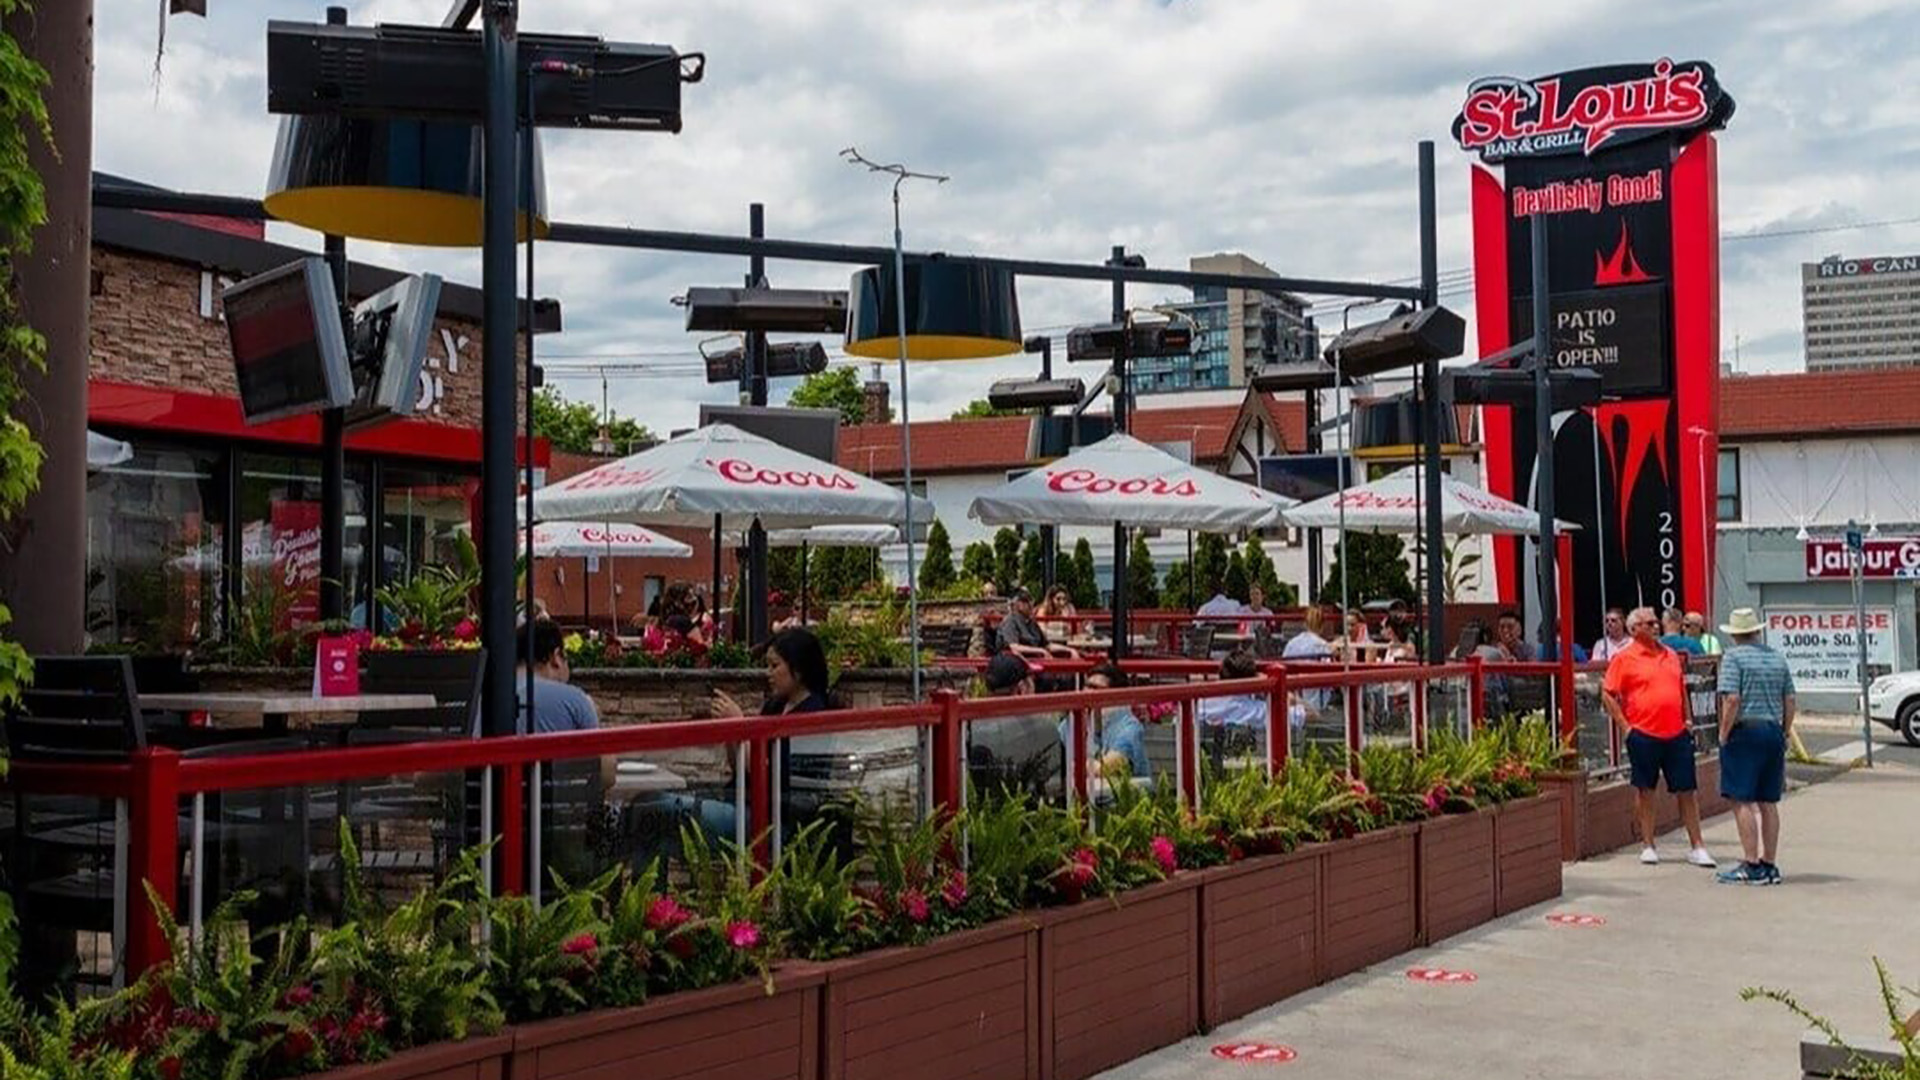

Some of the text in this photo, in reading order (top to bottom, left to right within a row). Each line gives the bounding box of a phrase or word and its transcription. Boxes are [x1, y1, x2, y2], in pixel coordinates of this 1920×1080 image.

[1607, 168, 1662, 207] Good!
[1821, 258, 1917, 276] RIO CAN
[1557, 308, 1616, 329] PATIO
[1579, 329, 1596, 345] IS
[1557, 346, 1618, 367] OPEN!!!
[708, 459, 857, 490] Coors
[1047, 469, 1199, 496] Coors
[579, 528, 653, 543] Coors
[1658, 511, 1676, 610] 2050
[1769, 614, 1889, 630] FOR LEASE
[1782, 633, 1828, 649] 3,000+
